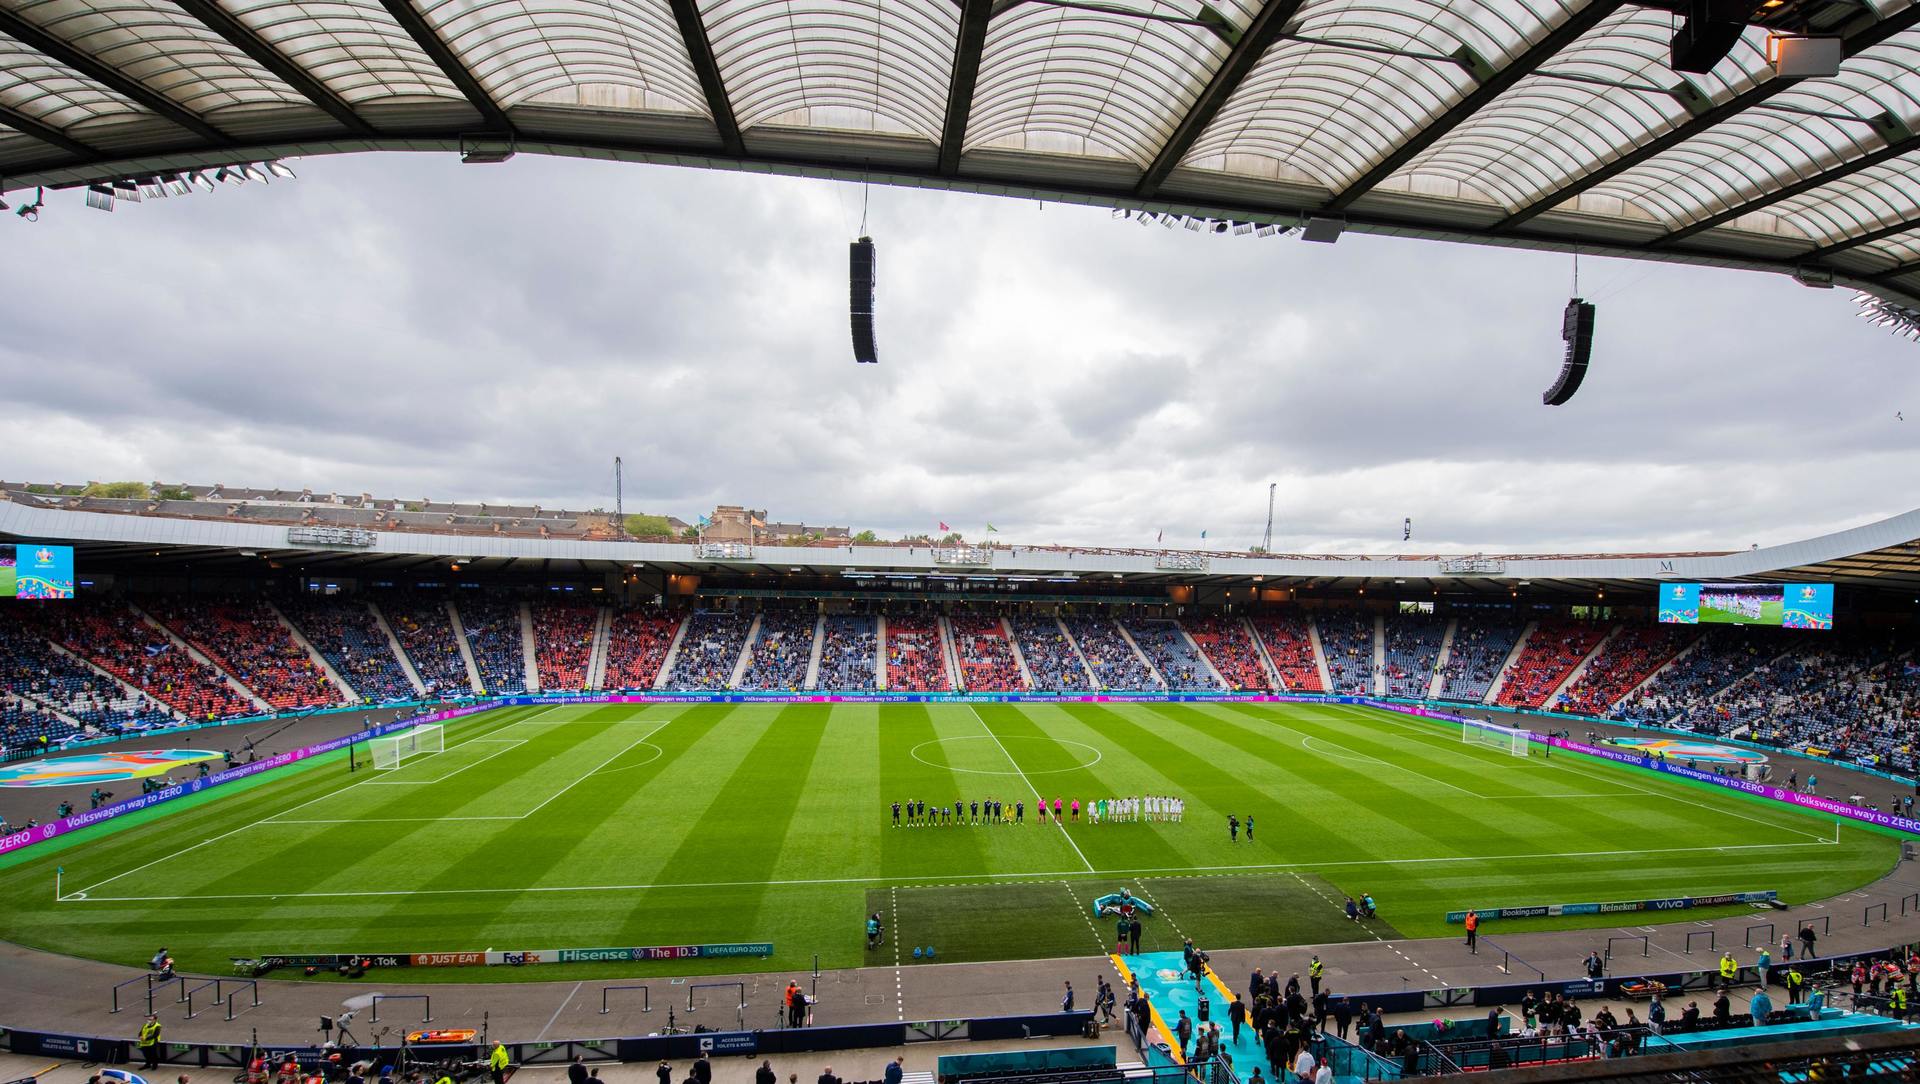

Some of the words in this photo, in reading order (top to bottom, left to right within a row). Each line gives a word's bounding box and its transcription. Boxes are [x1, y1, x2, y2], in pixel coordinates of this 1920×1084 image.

[1566, 741, 1601, 755] Volkswagen
[1623, 754, 1642, 764] ZERO
[210, 765, 252, 784] Volkswagen
[267, 758, 274, 766] to
[275, 753, 292, 765] ZERO
[1666, 764, 1712, 781] Volkswagen
[1712, 775, 1729, 786] way
[1730, 779, 1739, 787] to
[1740, 780, 1765, 793] ZERO
[67, 804, 126, 828] Volkswagen
[127, 797, 147, 810] way
[147, 793, 158, 803] to
[159, 785, 183, 800] ZERO
[1794, 793, 1852, 814] Volkswagen
[1854, 808, 1876, 822] way
[1877, 813, 1889, 823] to
[1891, 816, 1920, 831] ZERO
[0, 831, 31, 851] ZERO
[1600, 904, 1637, 912] Heineken
[1656, 899, 1684, 909] vivo
[1502, 908, 1546, 918] Booking.com
[503, 952, 541, 964] FedEx
[563, 950, 629, 961] Hisense
[649, 948, 671, 958] The
[676, 947, 699, 957] ID.3
[431, 954, 457, 965] JUST
[458, 953, 480, 963] EAT
